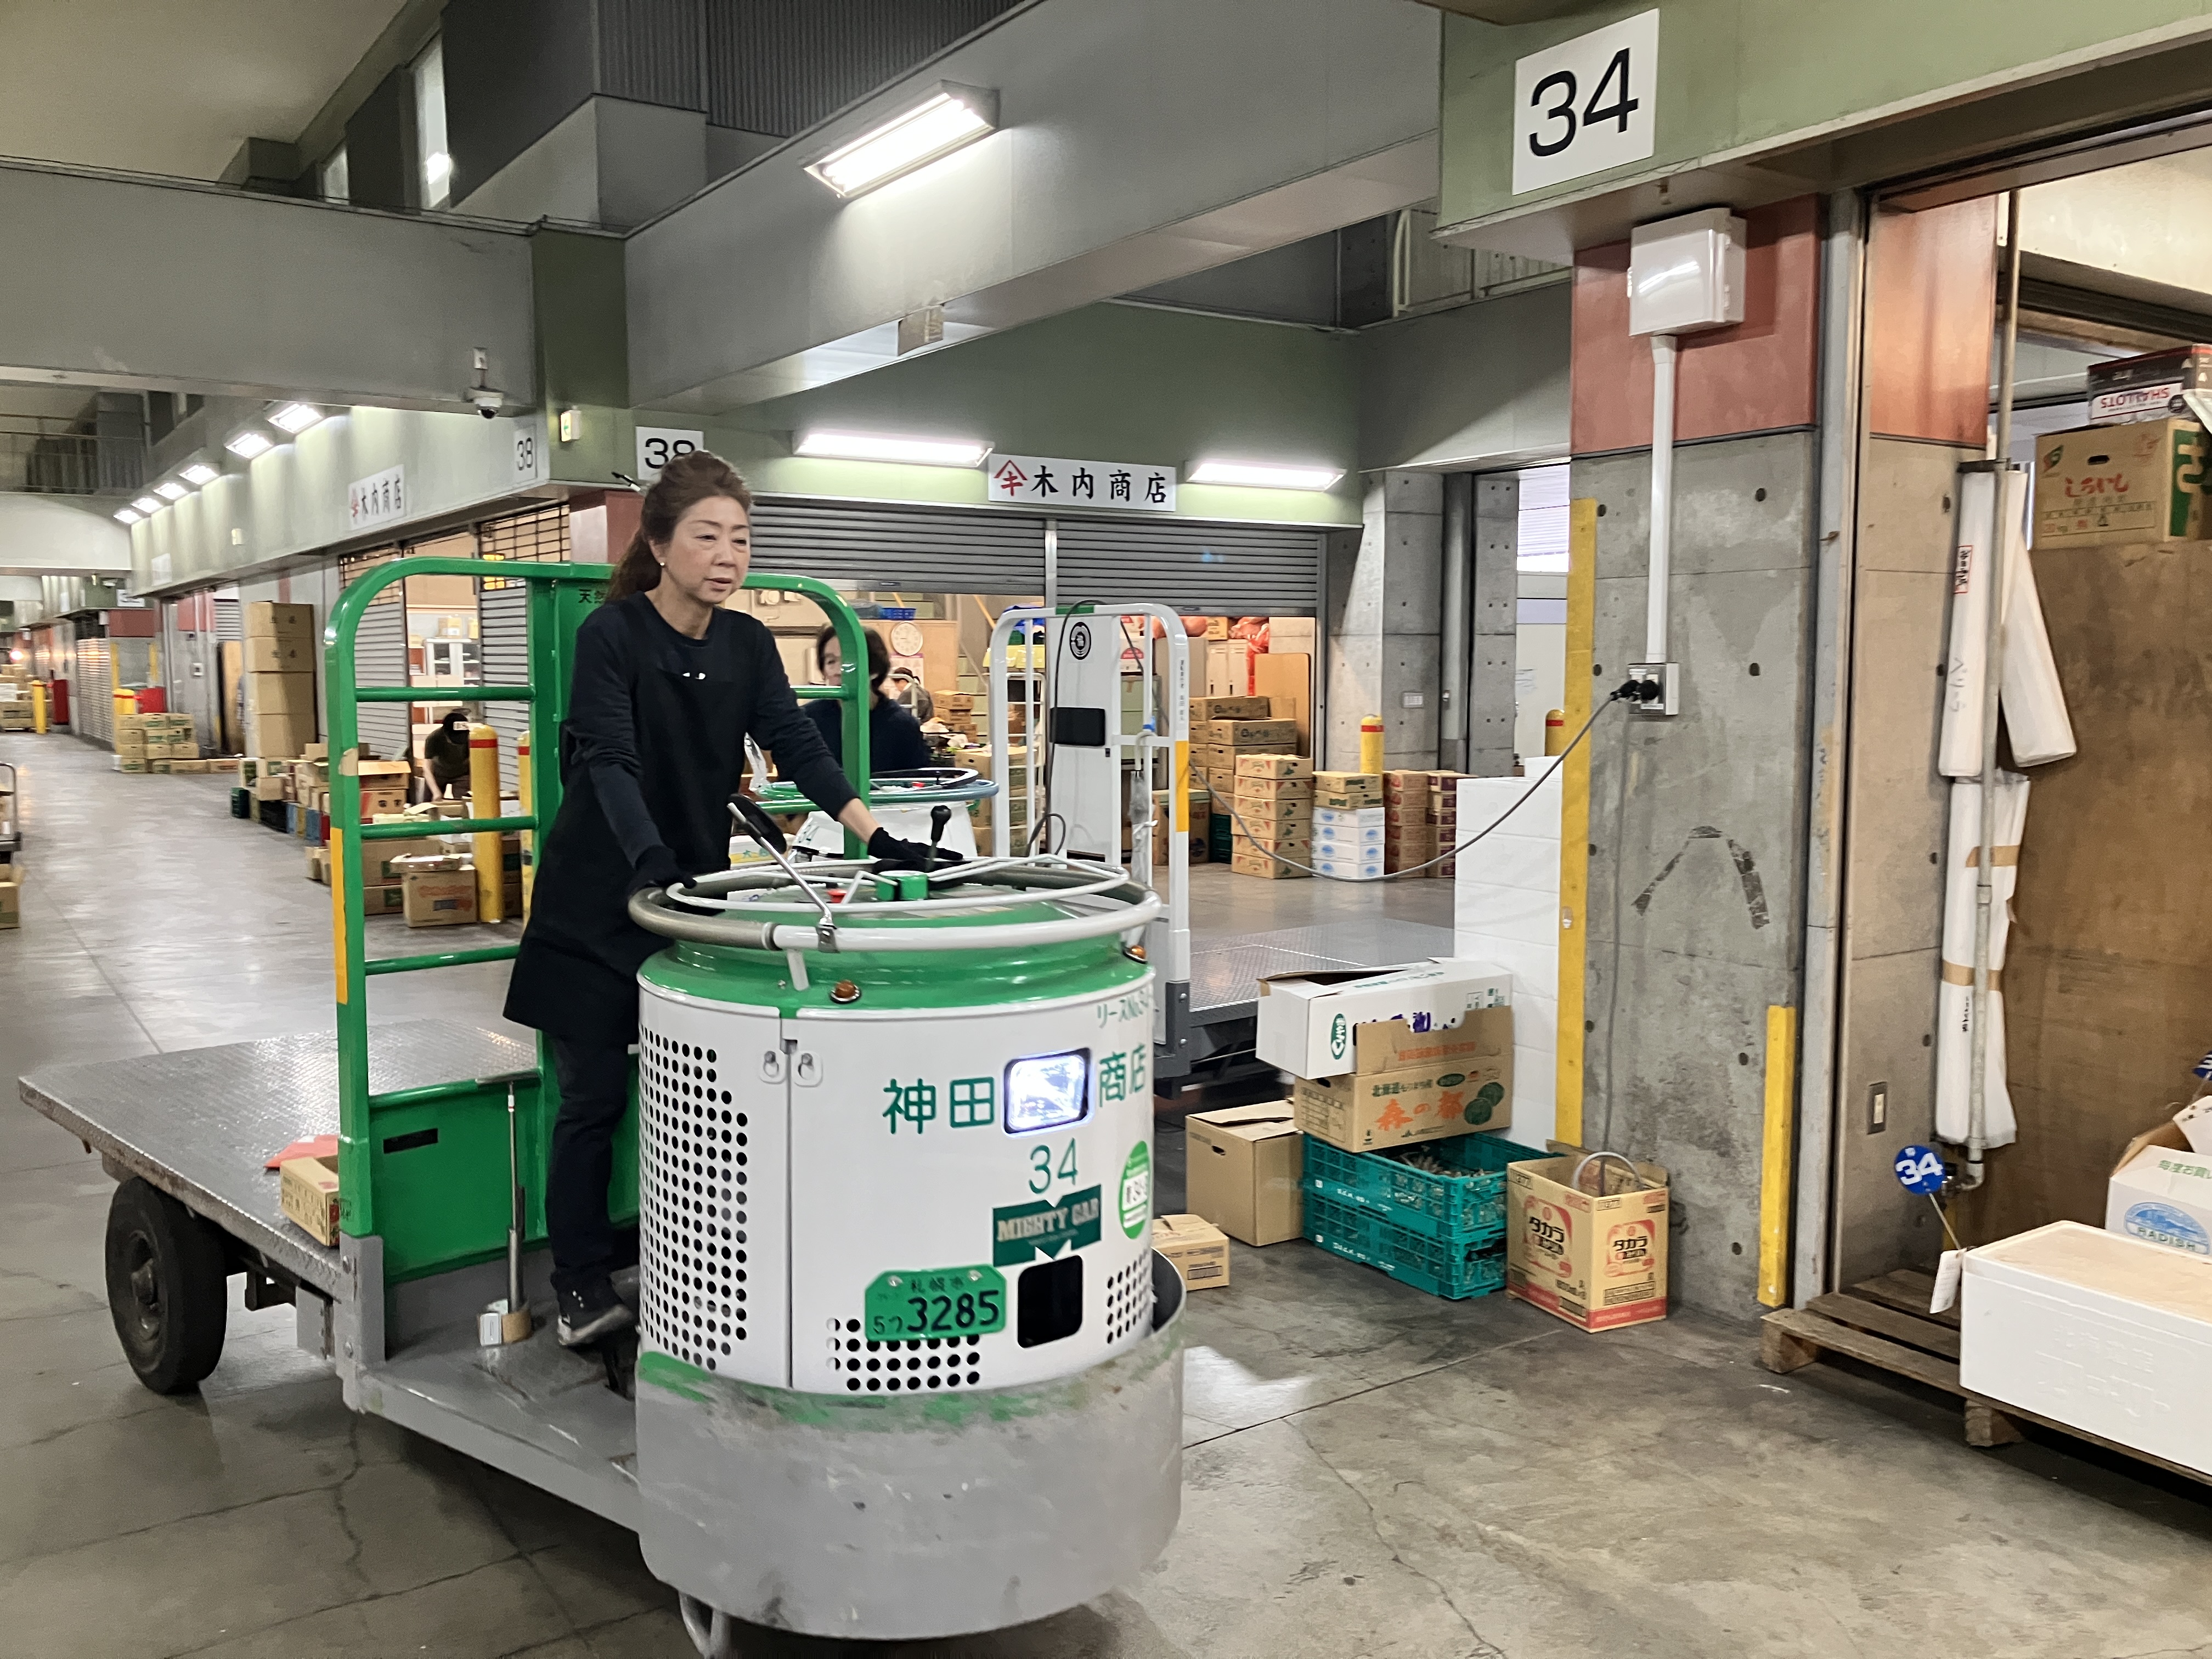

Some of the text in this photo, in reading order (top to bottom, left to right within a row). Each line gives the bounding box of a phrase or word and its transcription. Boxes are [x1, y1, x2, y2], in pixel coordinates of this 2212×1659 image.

[1529, 47, 1639, 157] 34
[517, 437, 533, 471] 38
[1030, 465, 1166, 504] 木内商店
[1029, 1138, 1077, 1194] 34
[1895, 1152, 1944, 1185] 34
[1530, 1216, 1564, 1243] タカラ
[1613, 1235, 1647, 1251] タカラ
[2137, 1227, 2196, 1251] RADISH
[907, 1290, 999, 1333] 3285
